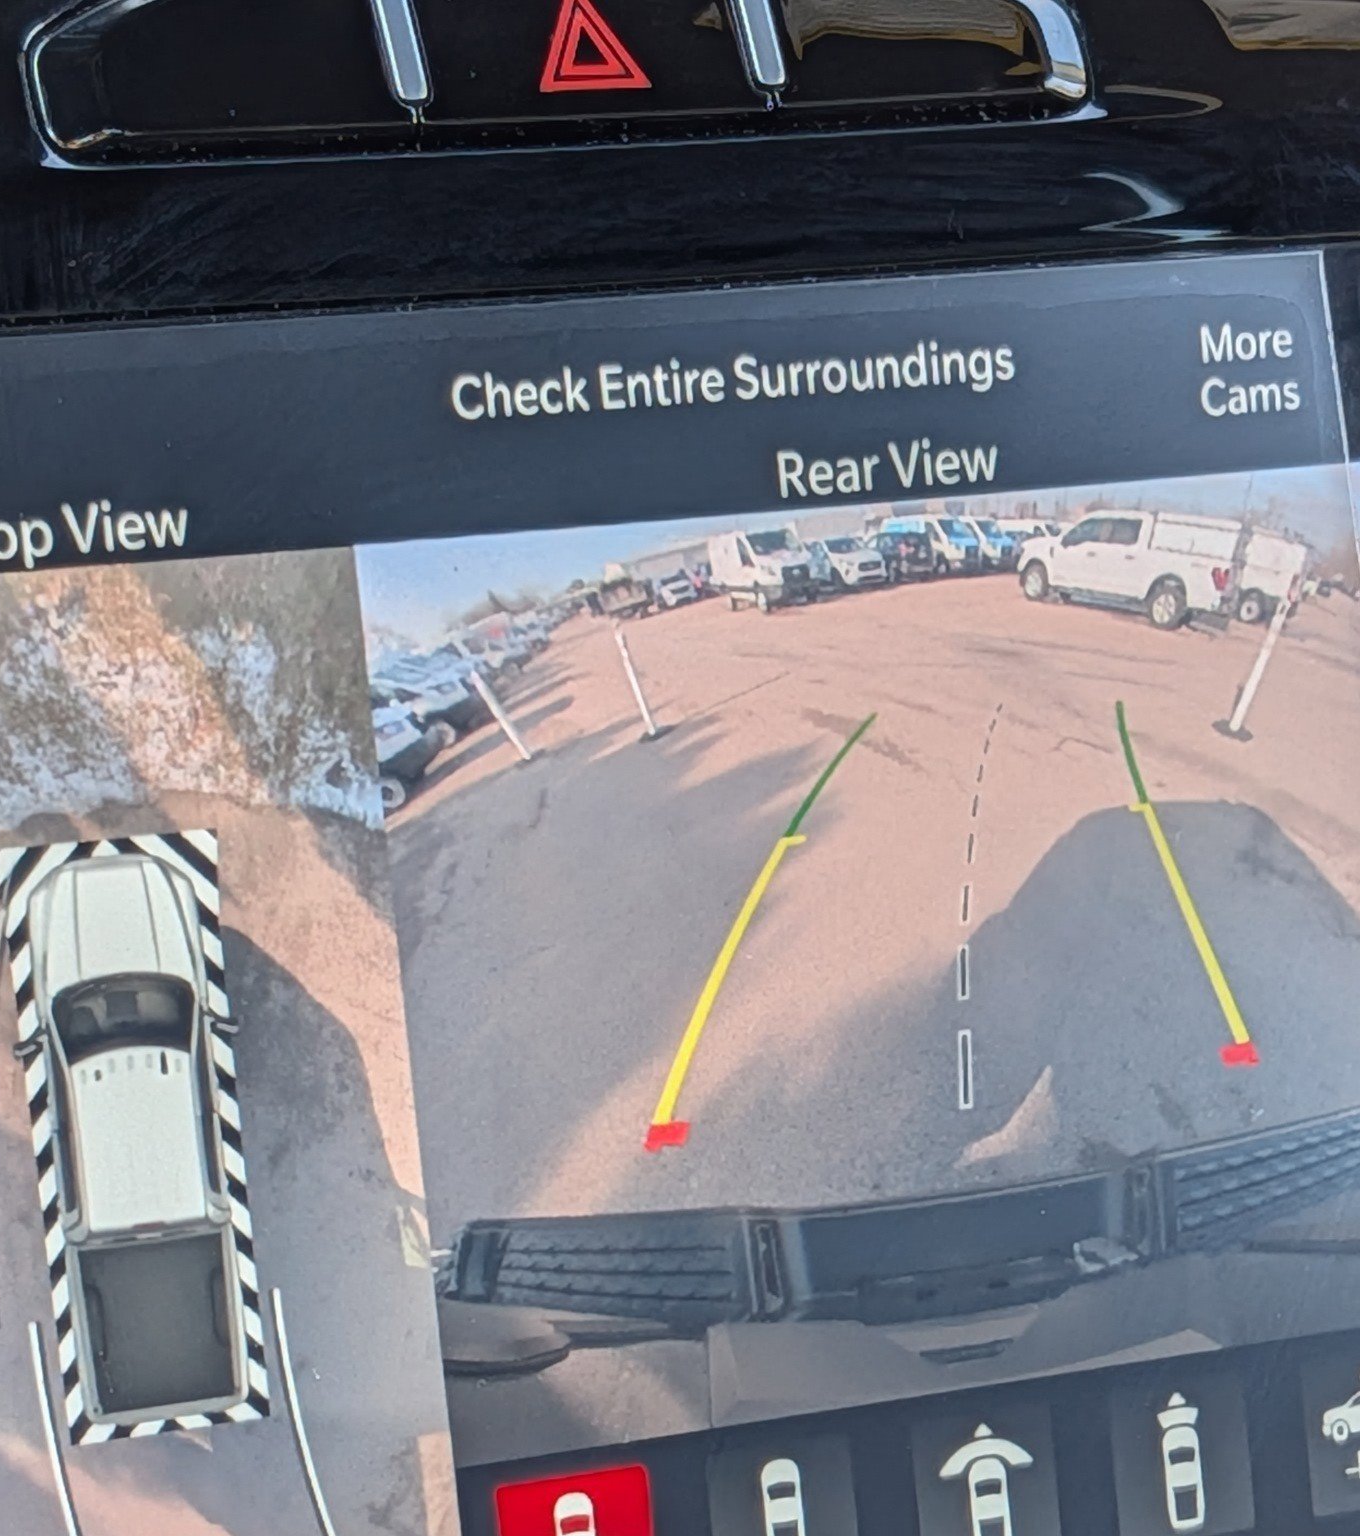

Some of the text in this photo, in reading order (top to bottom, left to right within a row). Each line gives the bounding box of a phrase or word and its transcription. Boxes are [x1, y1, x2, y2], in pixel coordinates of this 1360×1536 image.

[1200, 324, 1293, 363] More
[452, 340, 1015, 421] Check Entire Surroundings
[1200, 378, 1300, 417] Cams
[776, 438, 998, 500] Rear View
[60, 498, 188, 553] View
